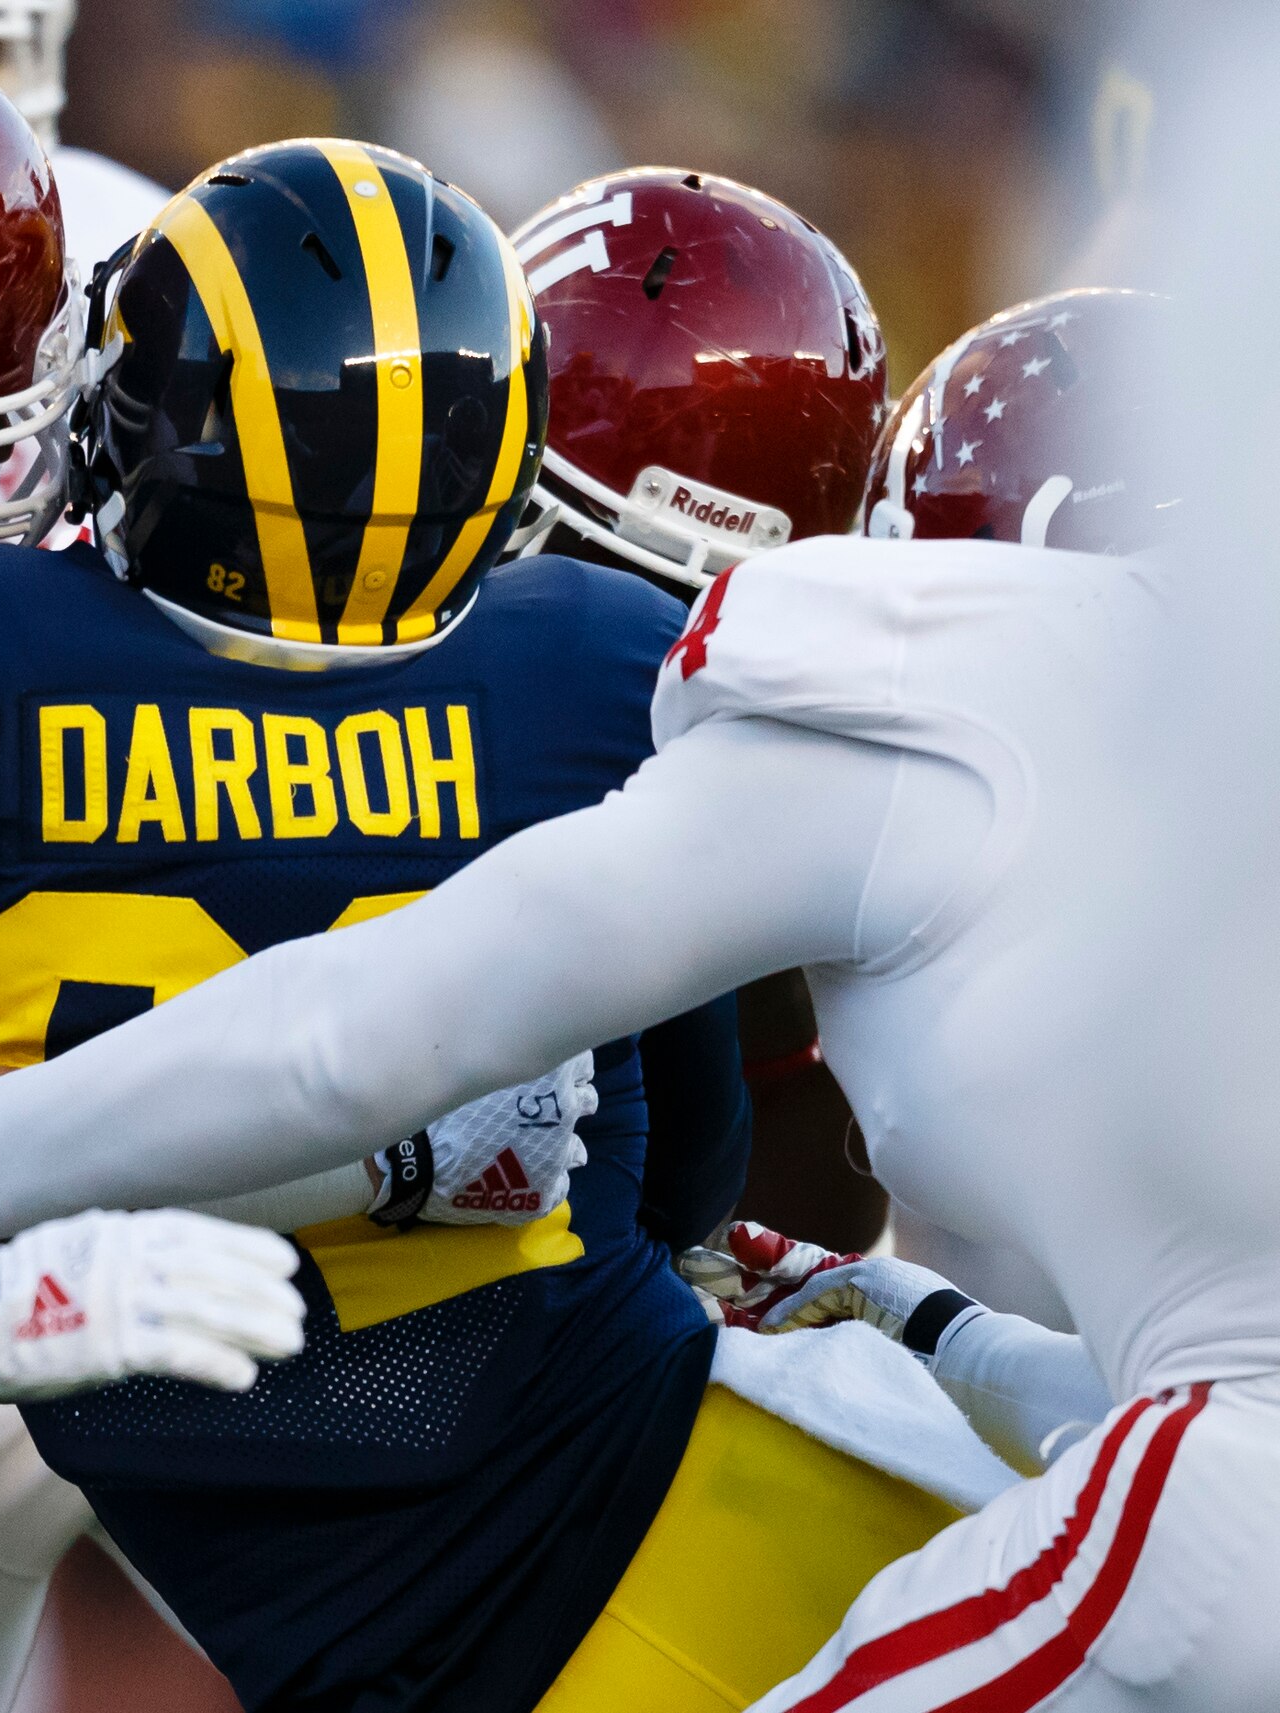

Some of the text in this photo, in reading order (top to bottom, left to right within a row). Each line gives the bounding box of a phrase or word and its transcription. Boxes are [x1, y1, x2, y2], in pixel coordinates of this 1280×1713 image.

[670, 485, 757, 534] Riddell
[207, 563, 246, 600] 82
[40, 704, 480, 843] DARBOH
[452, 1191, 541, 1211] adidas
